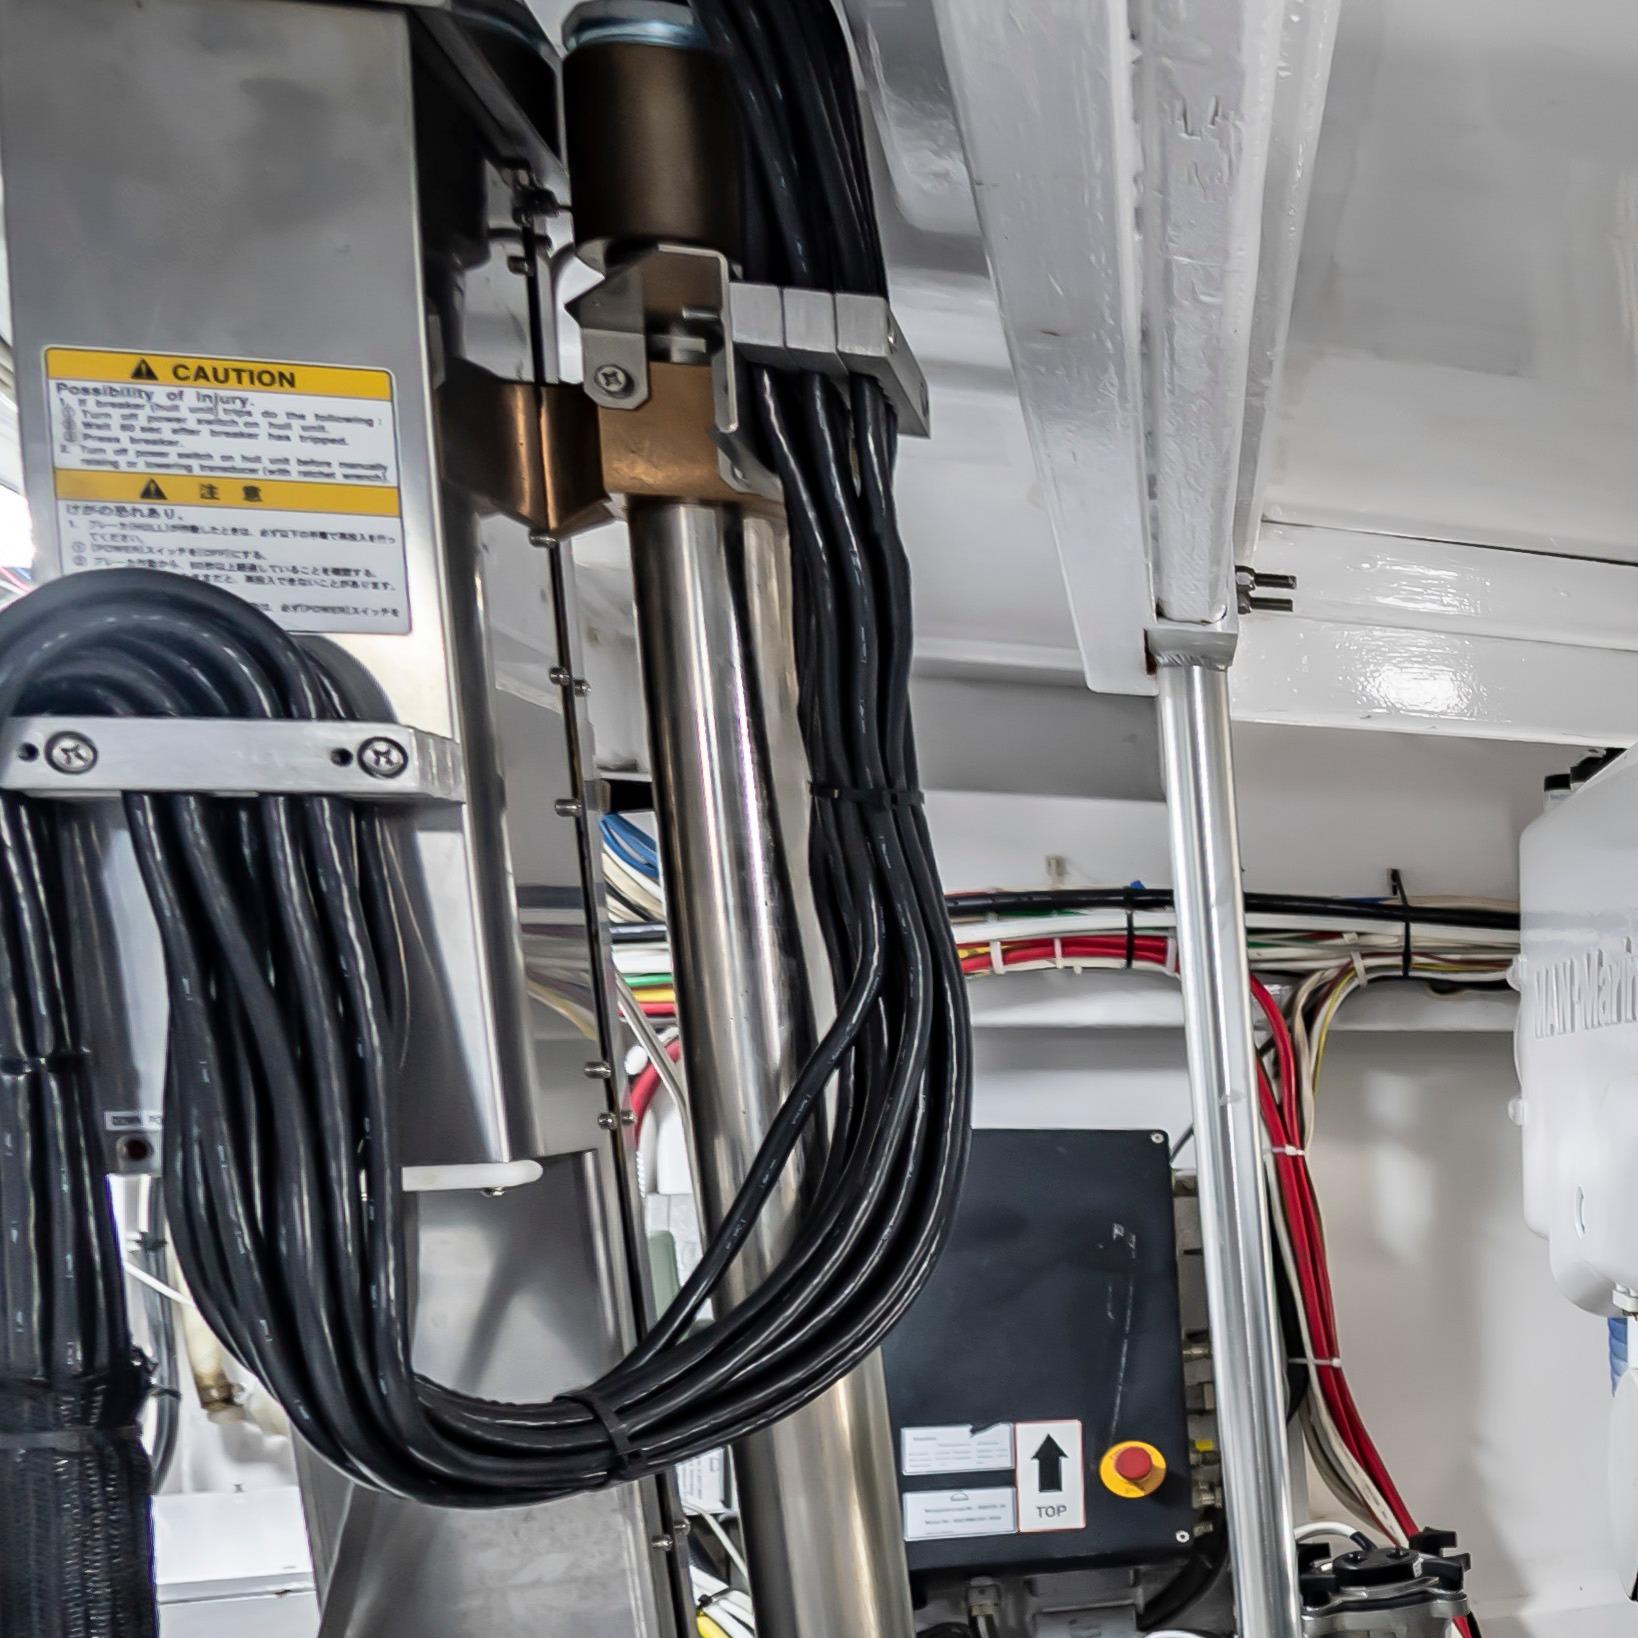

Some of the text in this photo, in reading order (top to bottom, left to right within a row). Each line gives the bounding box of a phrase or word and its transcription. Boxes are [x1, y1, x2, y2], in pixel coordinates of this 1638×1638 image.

[172, 364, 296, 389] CAUTION
[56, 382, 154, 401] Possibility
[166, 390, 184, 401] of
[1036, 1504, 1068, 1518] TOP
